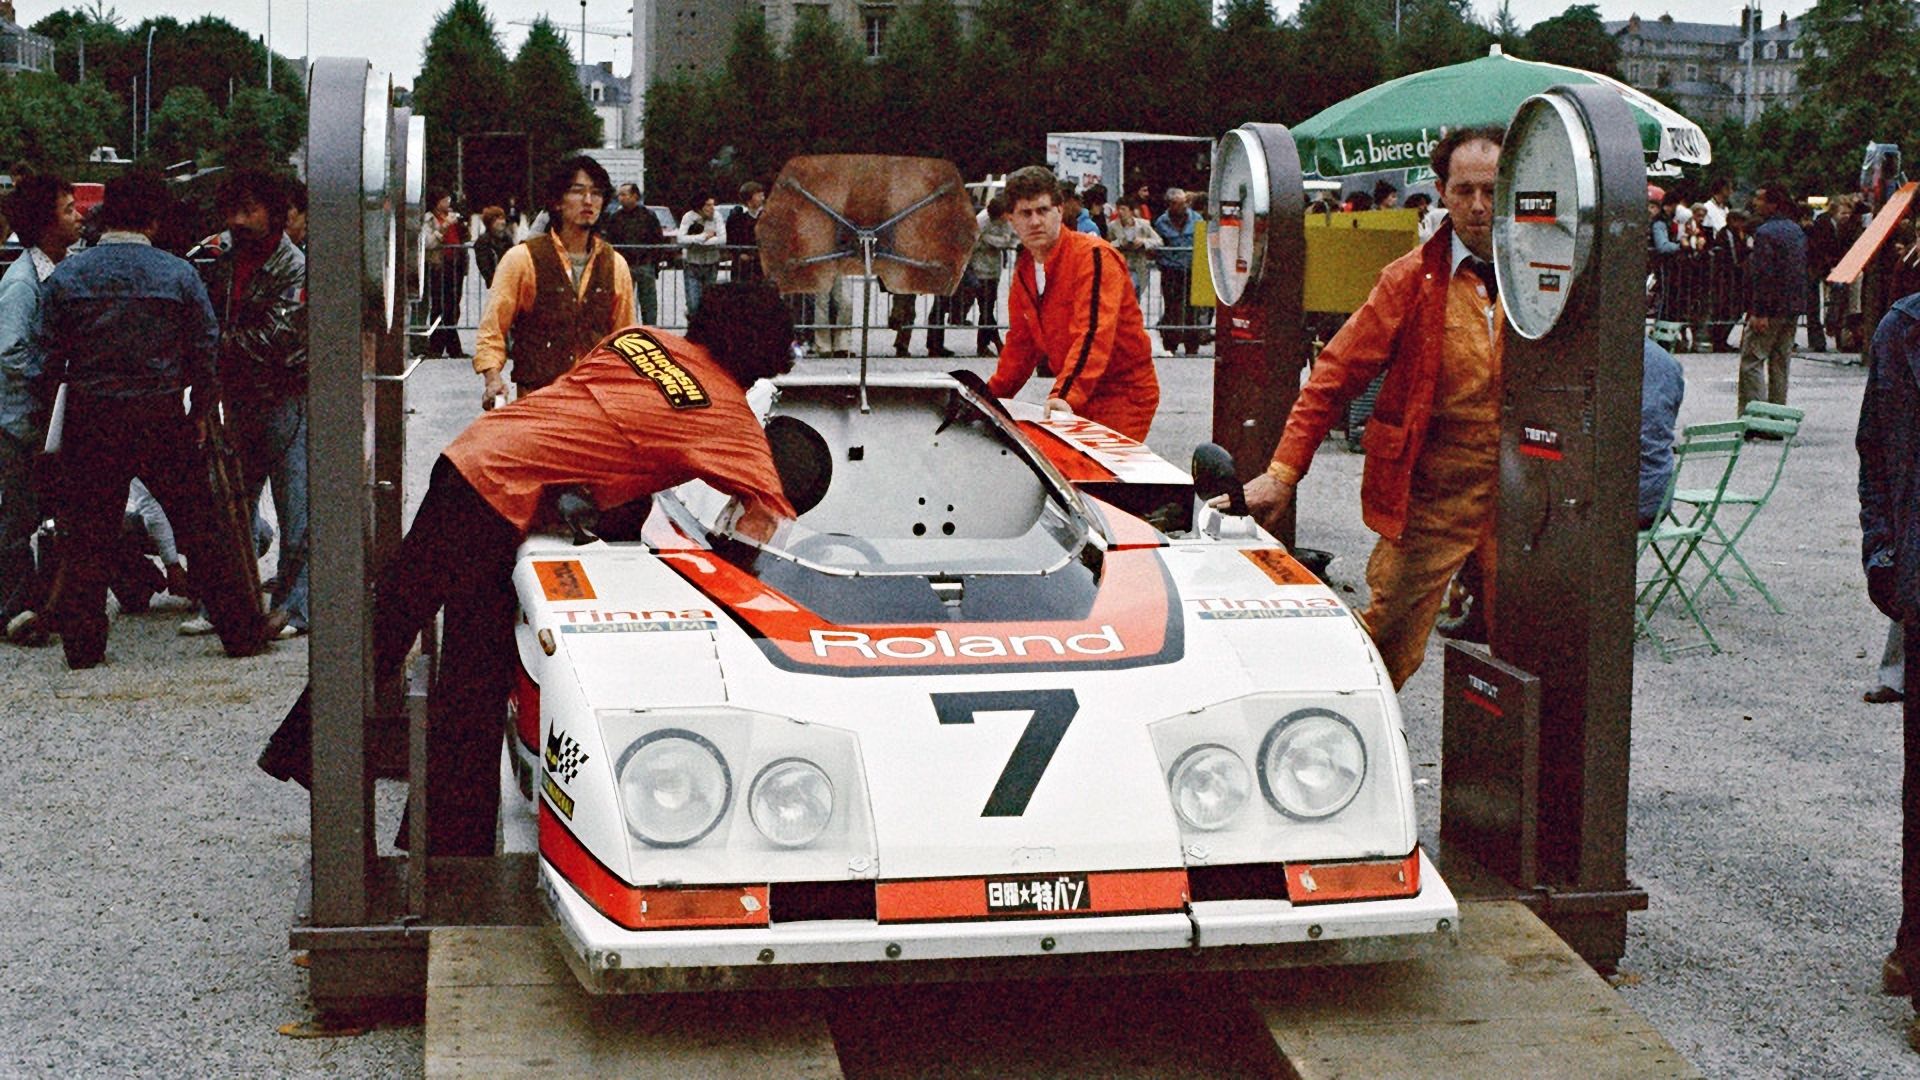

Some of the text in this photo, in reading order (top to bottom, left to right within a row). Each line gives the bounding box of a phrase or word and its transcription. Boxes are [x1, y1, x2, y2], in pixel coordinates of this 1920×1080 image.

[1336, 137, 1366, 168] La
[1183, 597, 1339, 611] Tinna
[552, 609, 714, 623] Tinna
[575, 620, 708, 634] TOSHIBA EMI
[809, 625, 1126, 660] Roland
[929, 688, 1080, 818] 7
